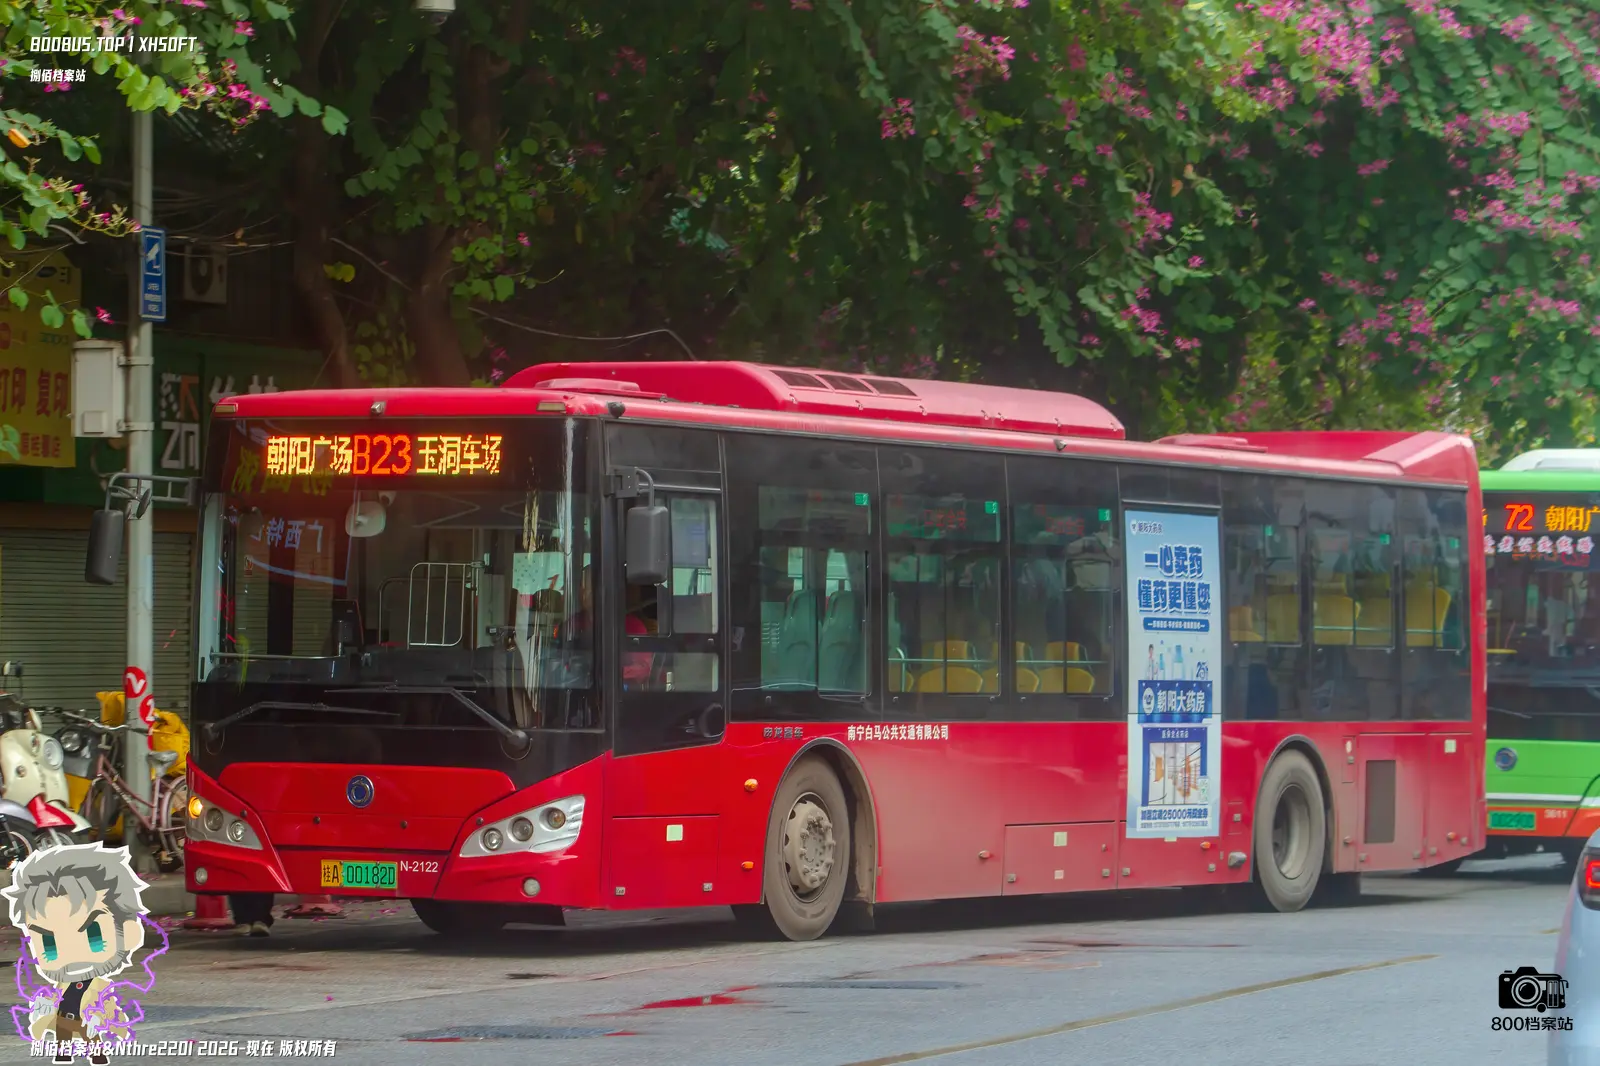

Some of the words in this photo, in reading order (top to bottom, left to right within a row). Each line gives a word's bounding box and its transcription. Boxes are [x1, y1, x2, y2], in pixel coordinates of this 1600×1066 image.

[267, 436, 352, 475] 朝阳广场
[353, 434, 412, 475] B23
[416, 435, 502, 475] 玉洞车场
[1504, 503, 1534, 531] 72
[1144, 544, 1203, 578] 一心卖药
[1137, 578, 1212, 614] 懂药更懂您
[1157, 690, 1205, 712] 朝阳大药房
[847, 724, 950, 741] 南宁白马公共交通有限公司
[400, 861, 439, 873] N-2122
